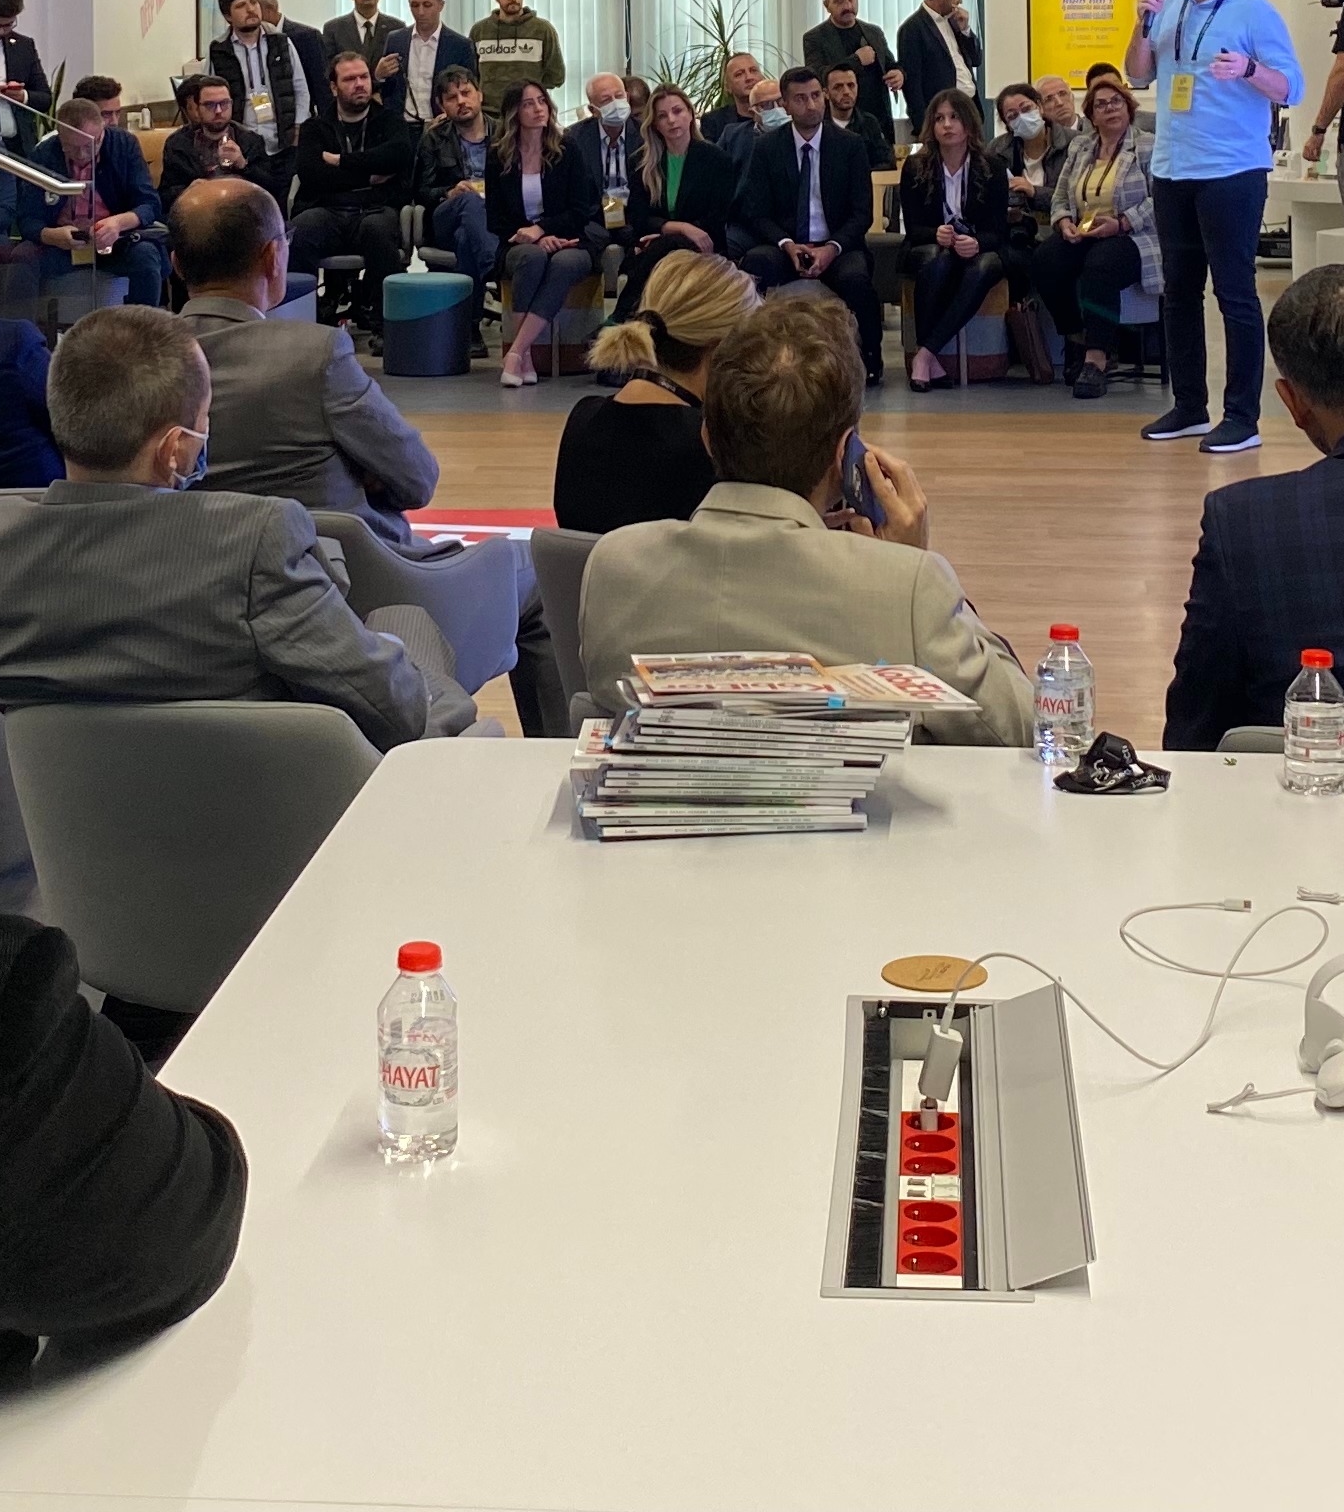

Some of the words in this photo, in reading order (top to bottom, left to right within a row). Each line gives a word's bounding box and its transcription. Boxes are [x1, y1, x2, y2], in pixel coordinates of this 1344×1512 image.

[479, 44, 517, 55] adidas
[1035, 695, 1074, 714] HAYAT
[382, 1062, 440, 1089] HAYAT
